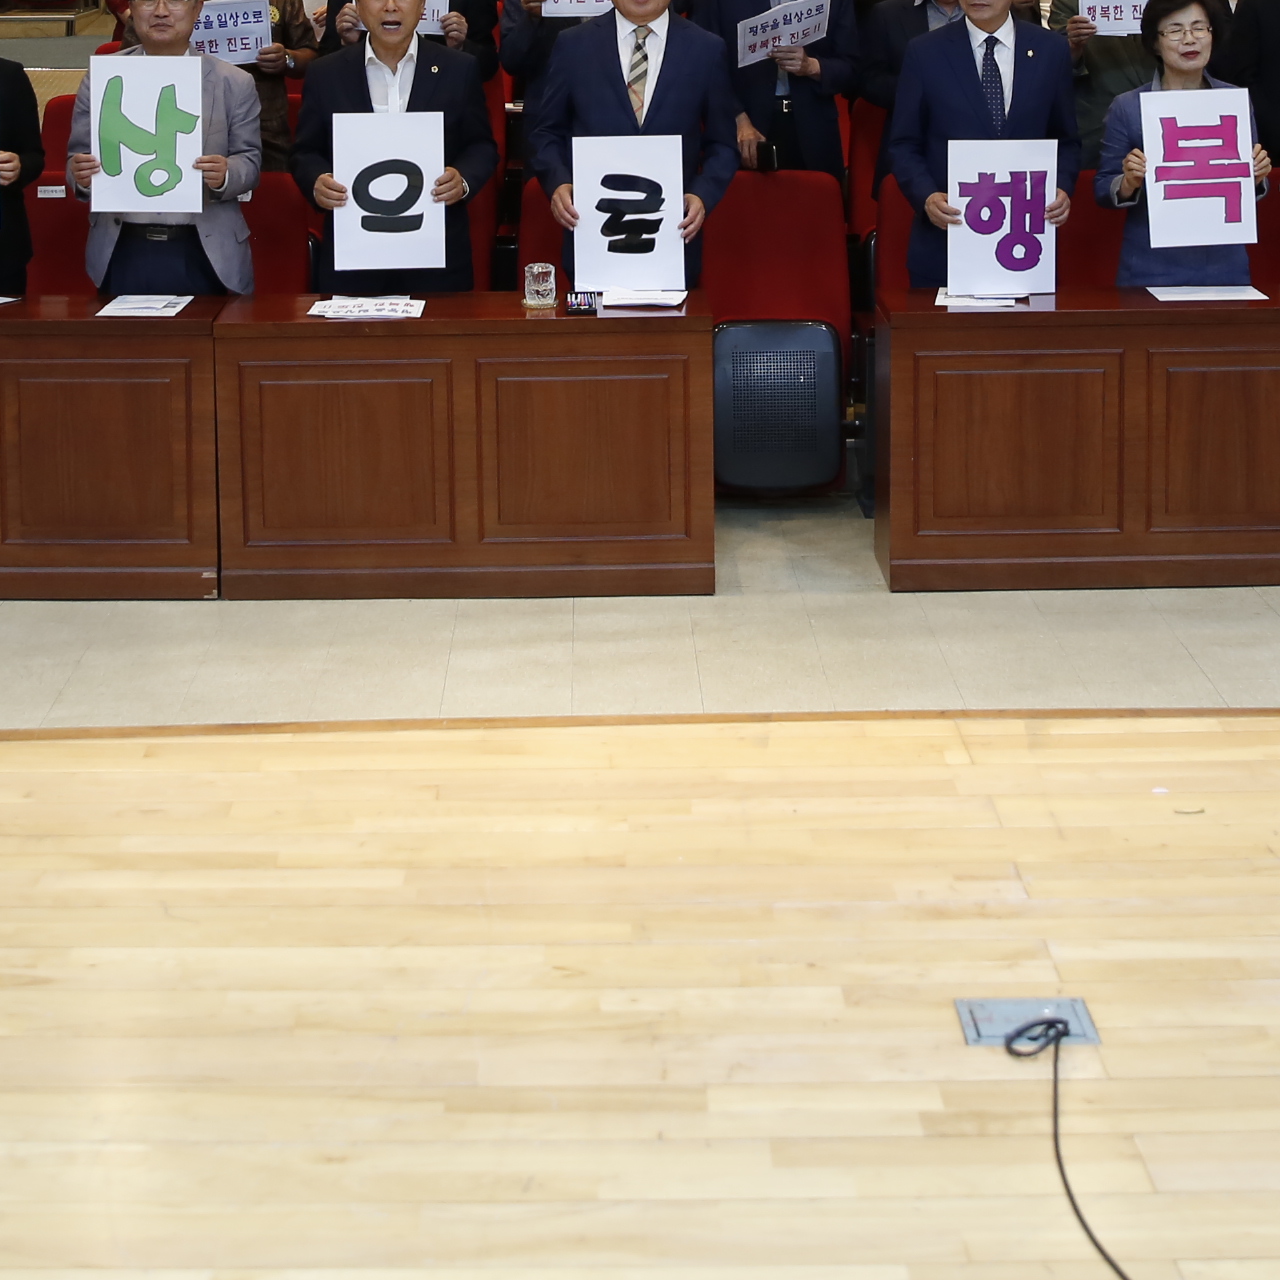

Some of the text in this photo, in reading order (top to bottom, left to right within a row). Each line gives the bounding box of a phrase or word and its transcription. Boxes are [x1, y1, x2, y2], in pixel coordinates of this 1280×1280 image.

[217, 9, 264, 30] 일상으로
[747, 22, 821, 54] 행복한 진도!!
[748, 4, 825, 37] 평등을 일상으로
[1086, 5, 1123, 22] 행복한
[227, 35, 264, 52] 진도!!
[97, 75, 201, 197] 상
[351, 158, 424, 232] 으
[1154, 114, 1251, 224] 복
[594, 173, 665, 254] 로
[957, 170, 1049, 272] 행
